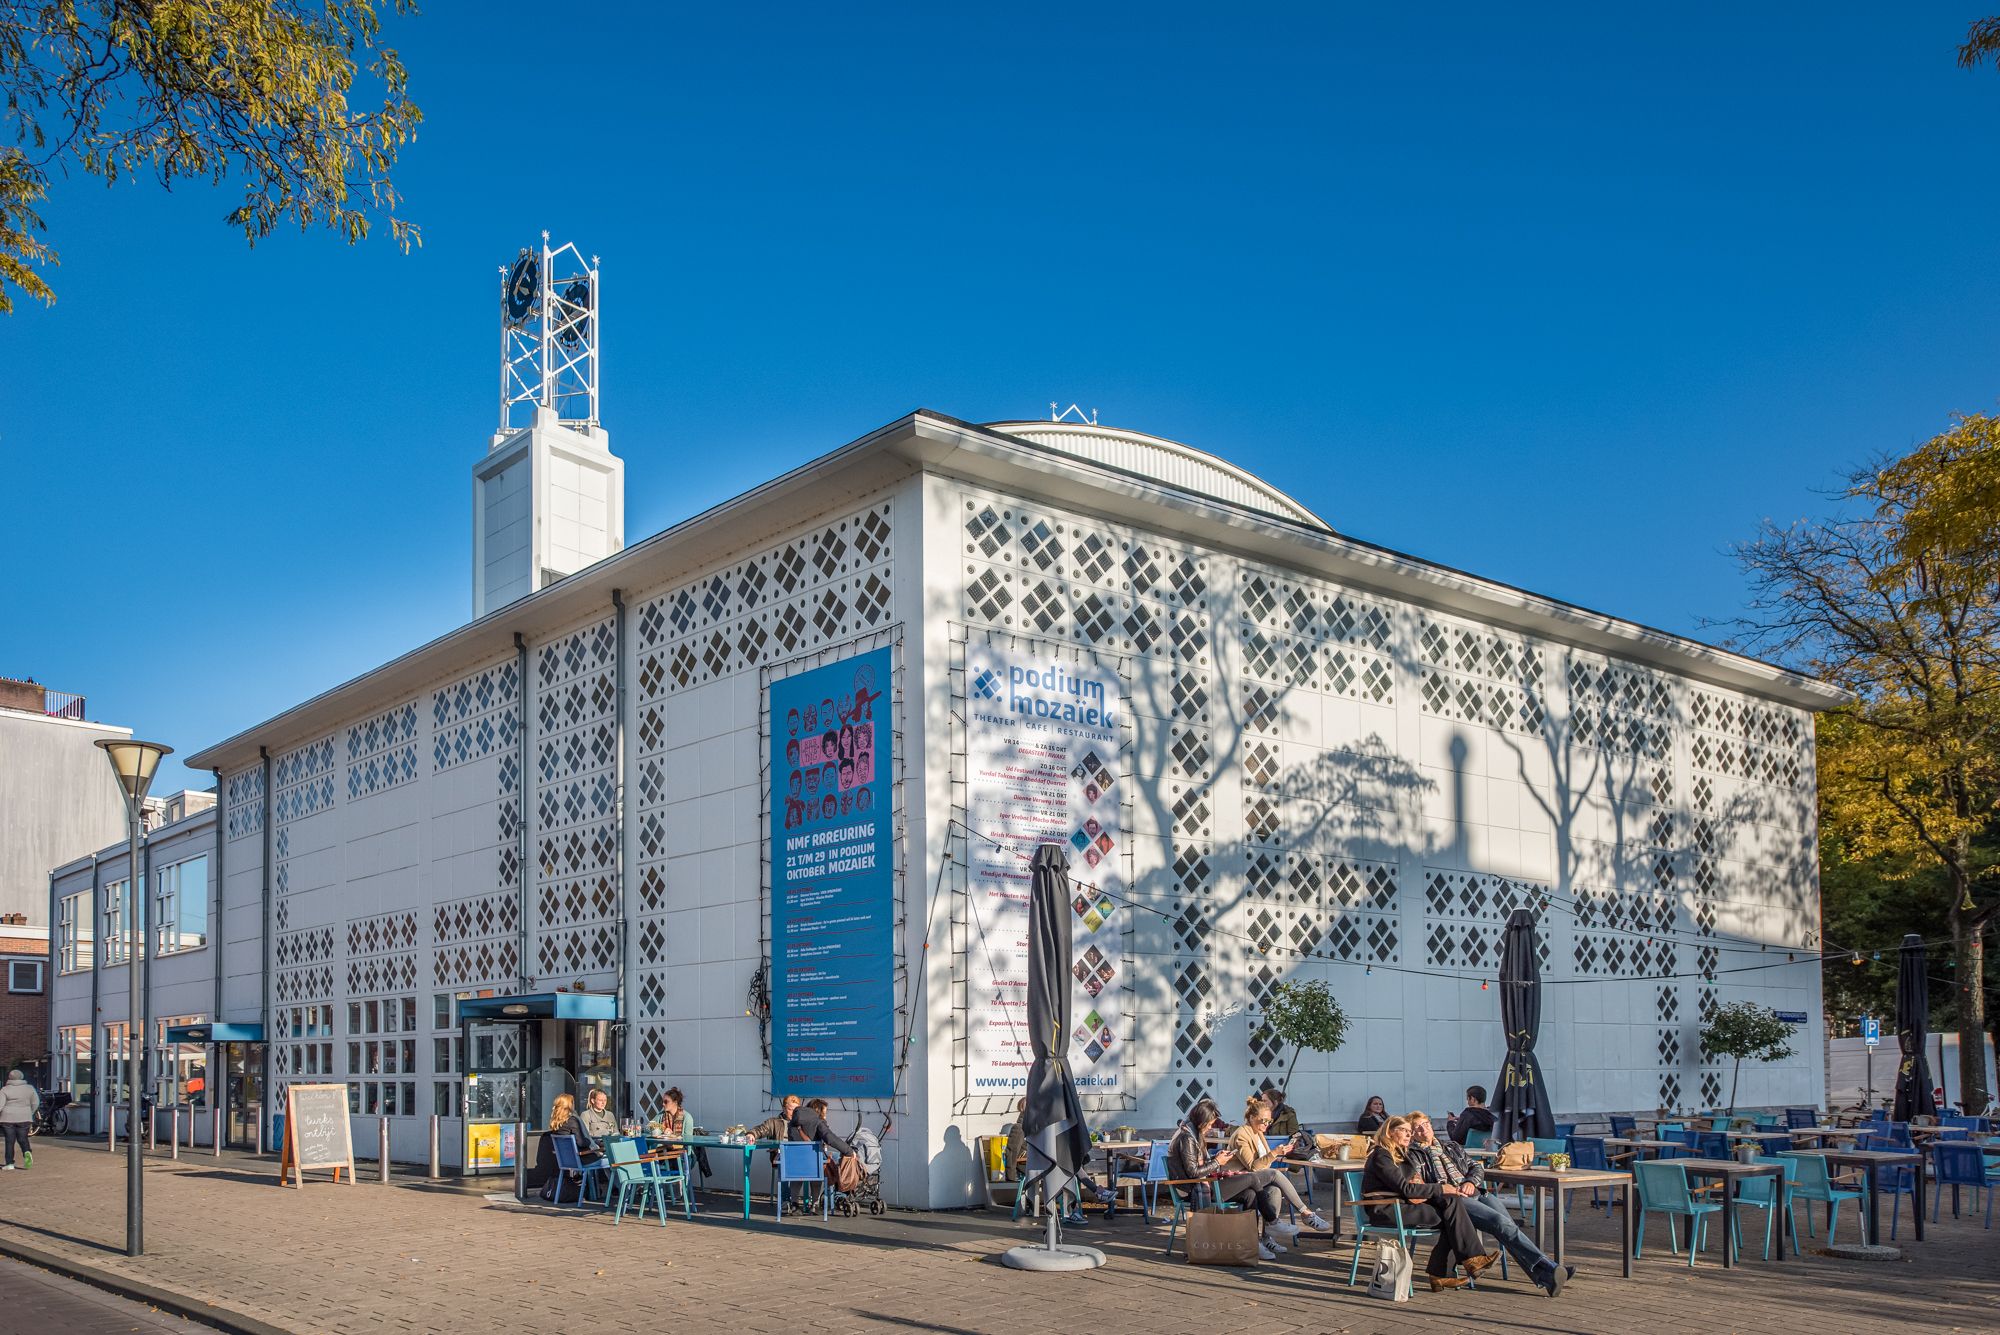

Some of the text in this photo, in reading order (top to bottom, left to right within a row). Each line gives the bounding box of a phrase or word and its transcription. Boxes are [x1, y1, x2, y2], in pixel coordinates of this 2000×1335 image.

[1010, 666, 1104, 699] podium
[1010, 694, 1113, 729] mozaïek
[974, 714, 1114, 743] THEATER CAFE RESTAURANT
[1000, 812, 1010, 821] Igor
[786, 823, 875, 851] NMF RRREURING
[786, 842, 875, 867] 21 T/M 29 IN PODIUM
[786, 855, 876, 880] OKTOBER MOZAIEK
[1869, 1023, 1876, 1034] P
[1193, 1241, 1242, 1250] COSTES
